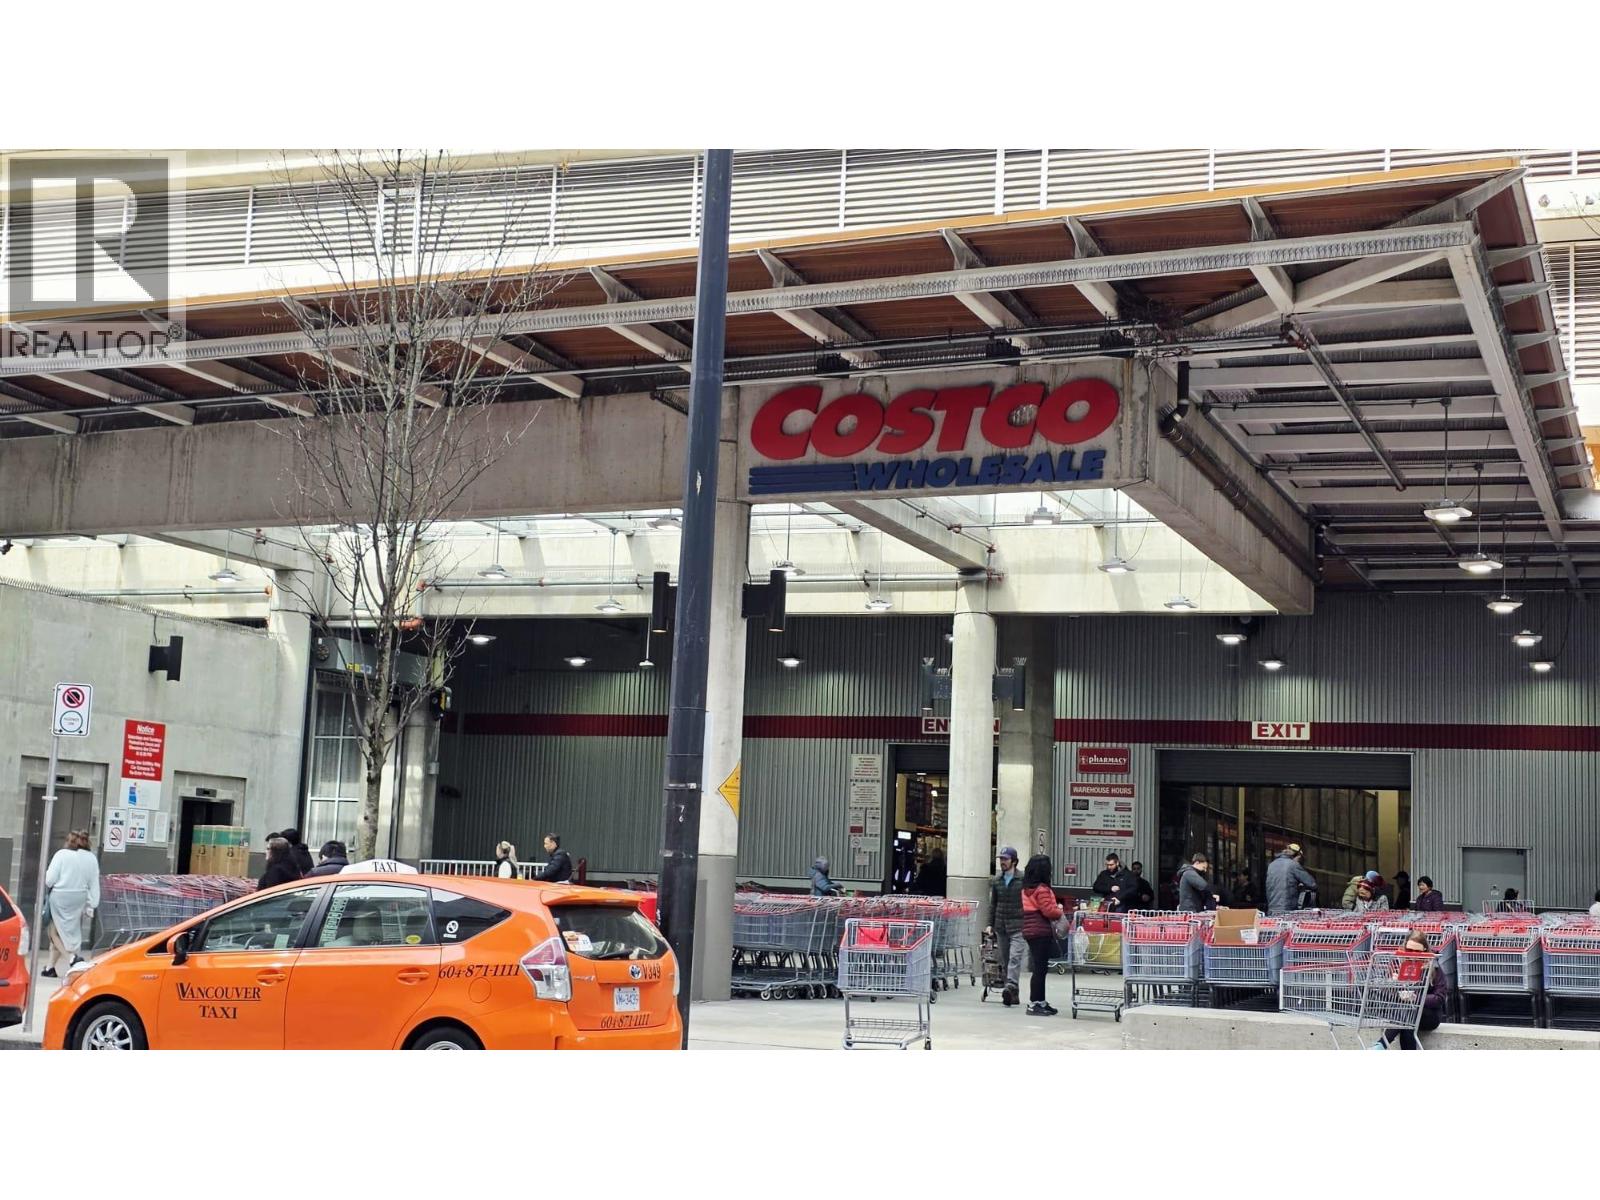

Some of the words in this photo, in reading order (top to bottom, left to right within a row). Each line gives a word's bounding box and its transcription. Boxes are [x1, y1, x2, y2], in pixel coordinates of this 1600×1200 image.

[751, 377, 1120, 460] COSTCO
[855, 450, 1107, 491] WHOLESALE
[1257, 723, 1306, 738] EXIT
[1072, 786, 1110, 794] WAREHOUSE
[1111, 787, 1132, 795] HOURS
[372, 861, 397, 873] TAXI
[438, 964, 520, 979] 604-871-1111
[642, 964, 661, 980] V349
[176, 982, 261, 999] VANCOUVER
[199, 1004, 238, 1019] TAXI
